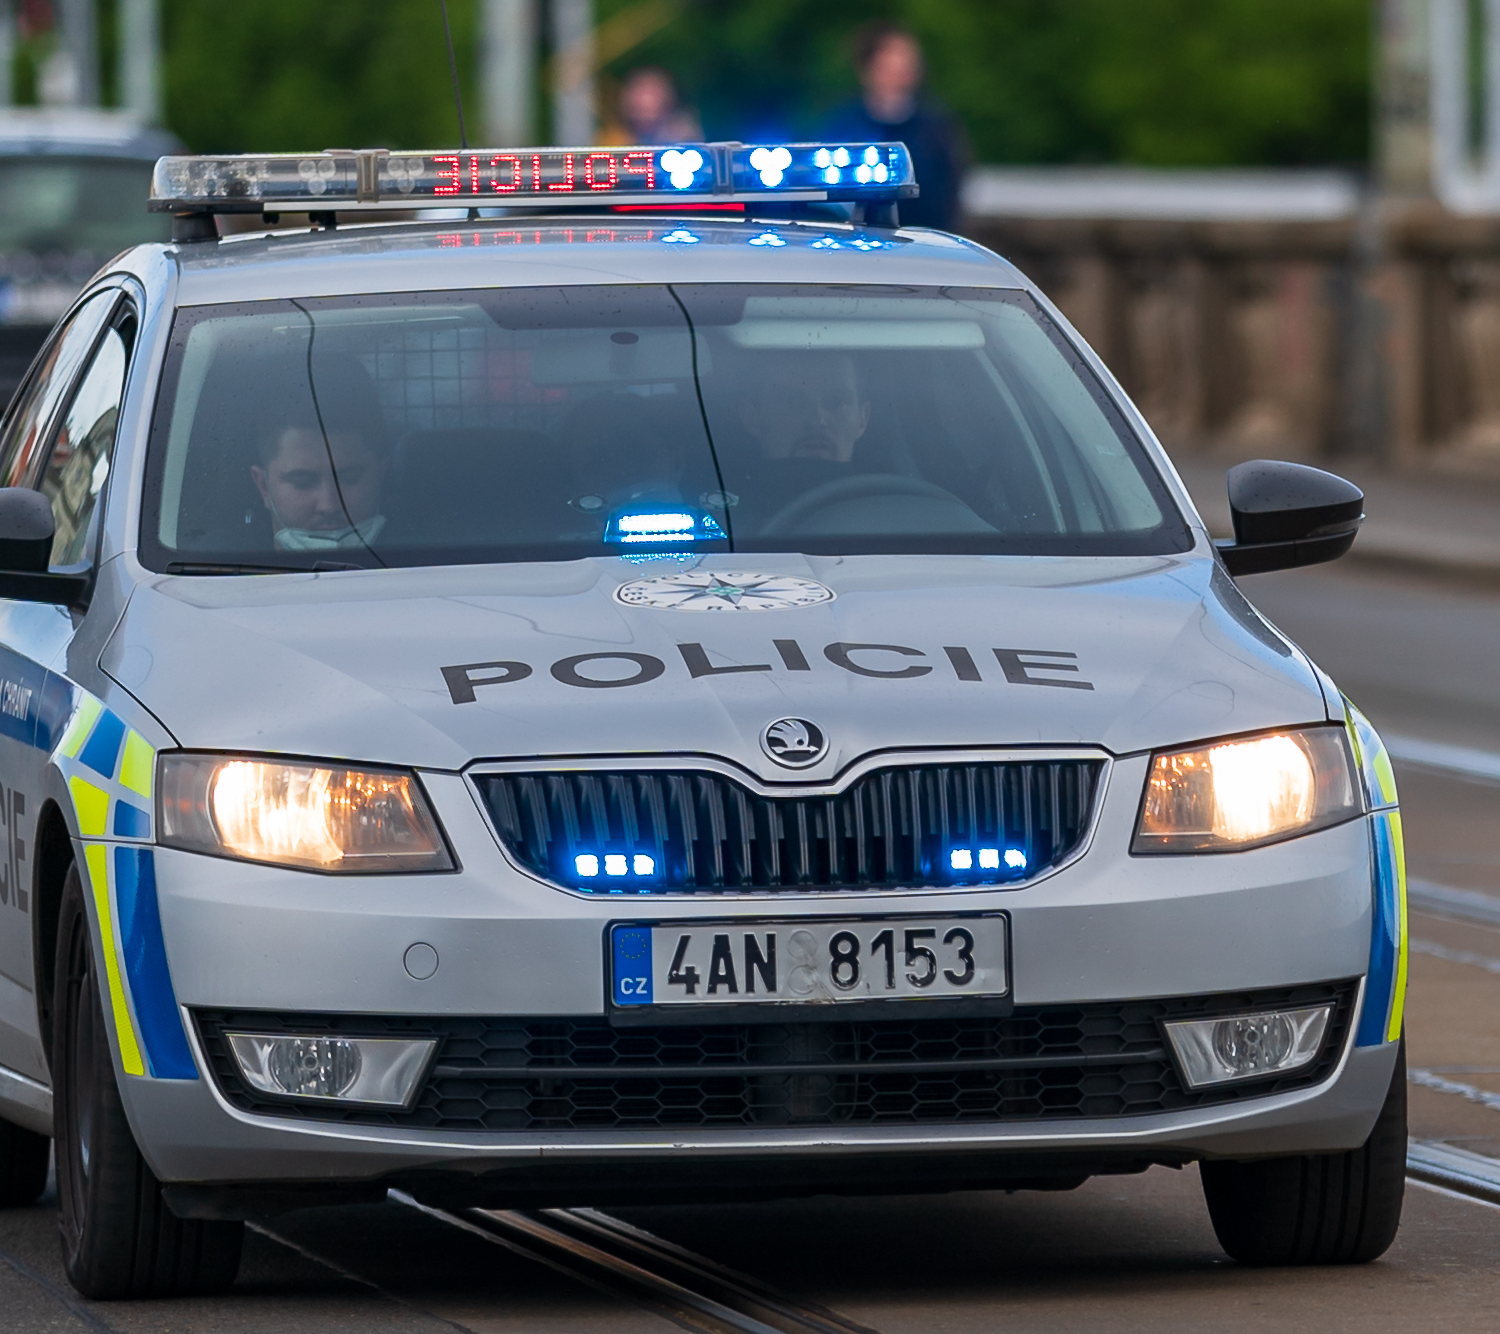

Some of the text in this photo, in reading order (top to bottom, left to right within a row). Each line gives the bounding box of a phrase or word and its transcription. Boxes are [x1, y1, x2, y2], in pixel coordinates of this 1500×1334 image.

[439, 639, 1095, 705] POLICIE
[620, 977, 648, 995] CZ
[668, 927, 976, 995] 4AN 8153
